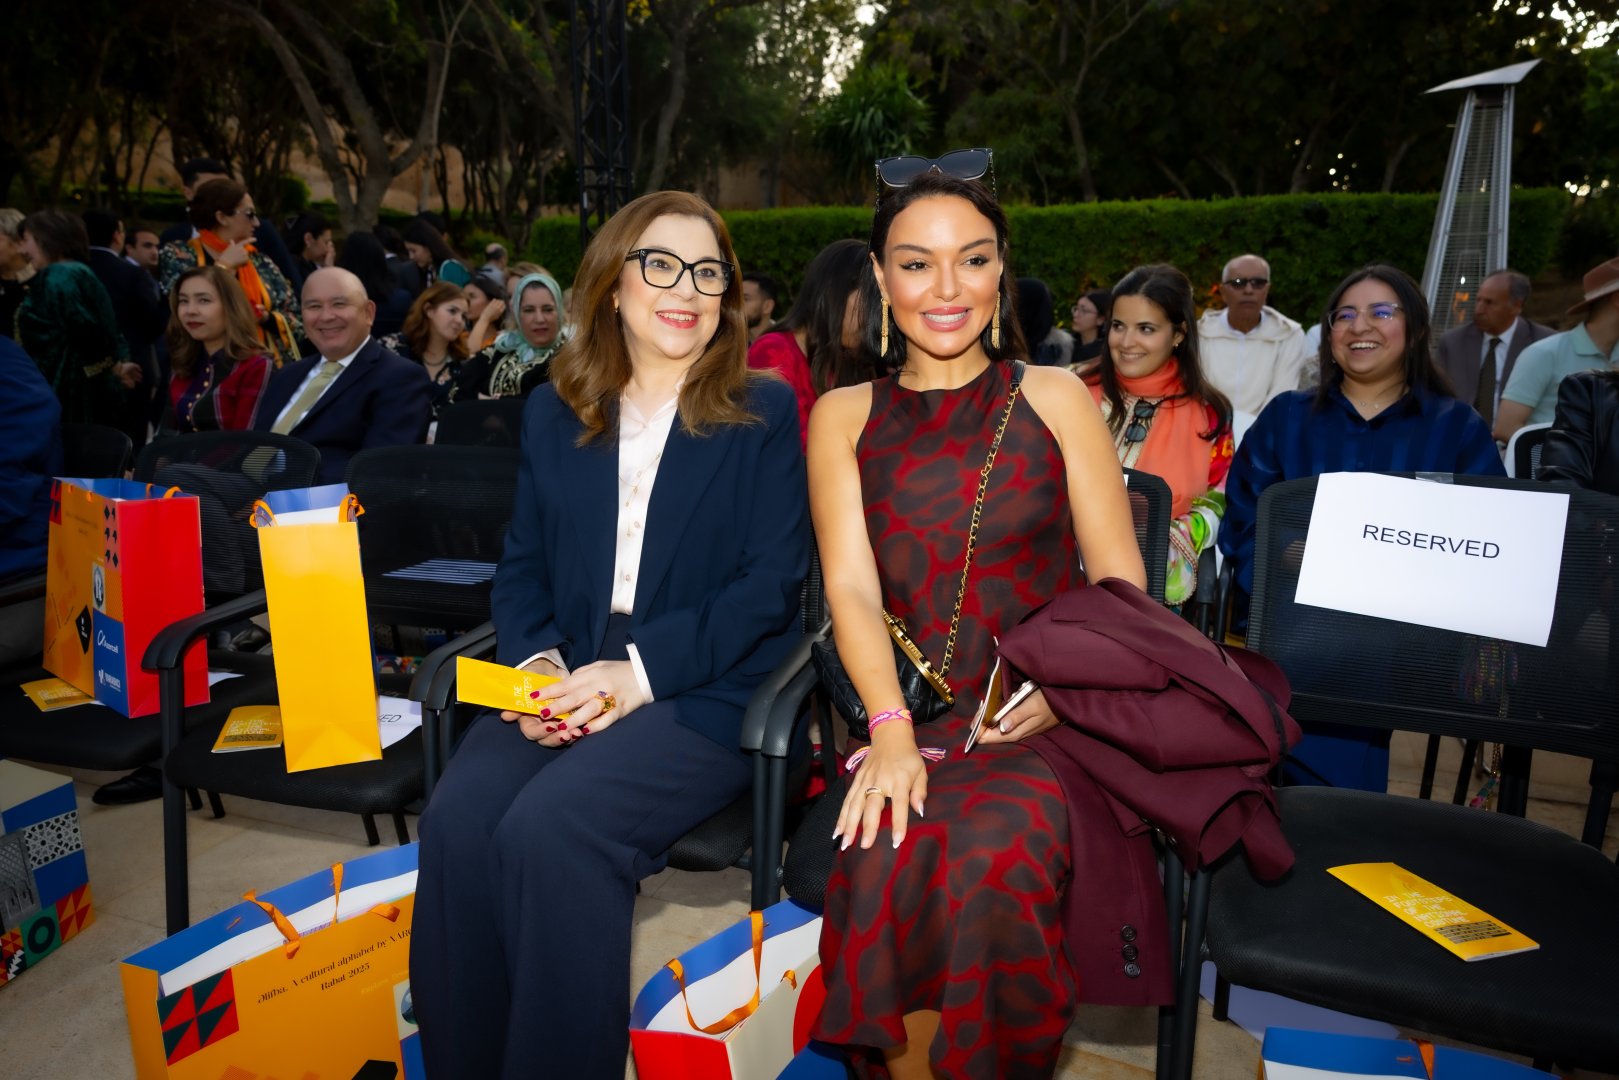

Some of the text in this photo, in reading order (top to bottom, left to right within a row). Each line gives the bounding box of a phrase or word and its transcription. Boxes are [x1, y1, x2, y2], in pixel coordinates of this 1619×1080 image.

[1363, 524, 1500, 559] RESERVED
[300, 961, 335, 984] cultural
[337, 944, 375, 967] alphabet
[377, 938, 388, 950] by
[321, 974, 346, 991] Rabat
[348, 962, 370, 978] 2025
